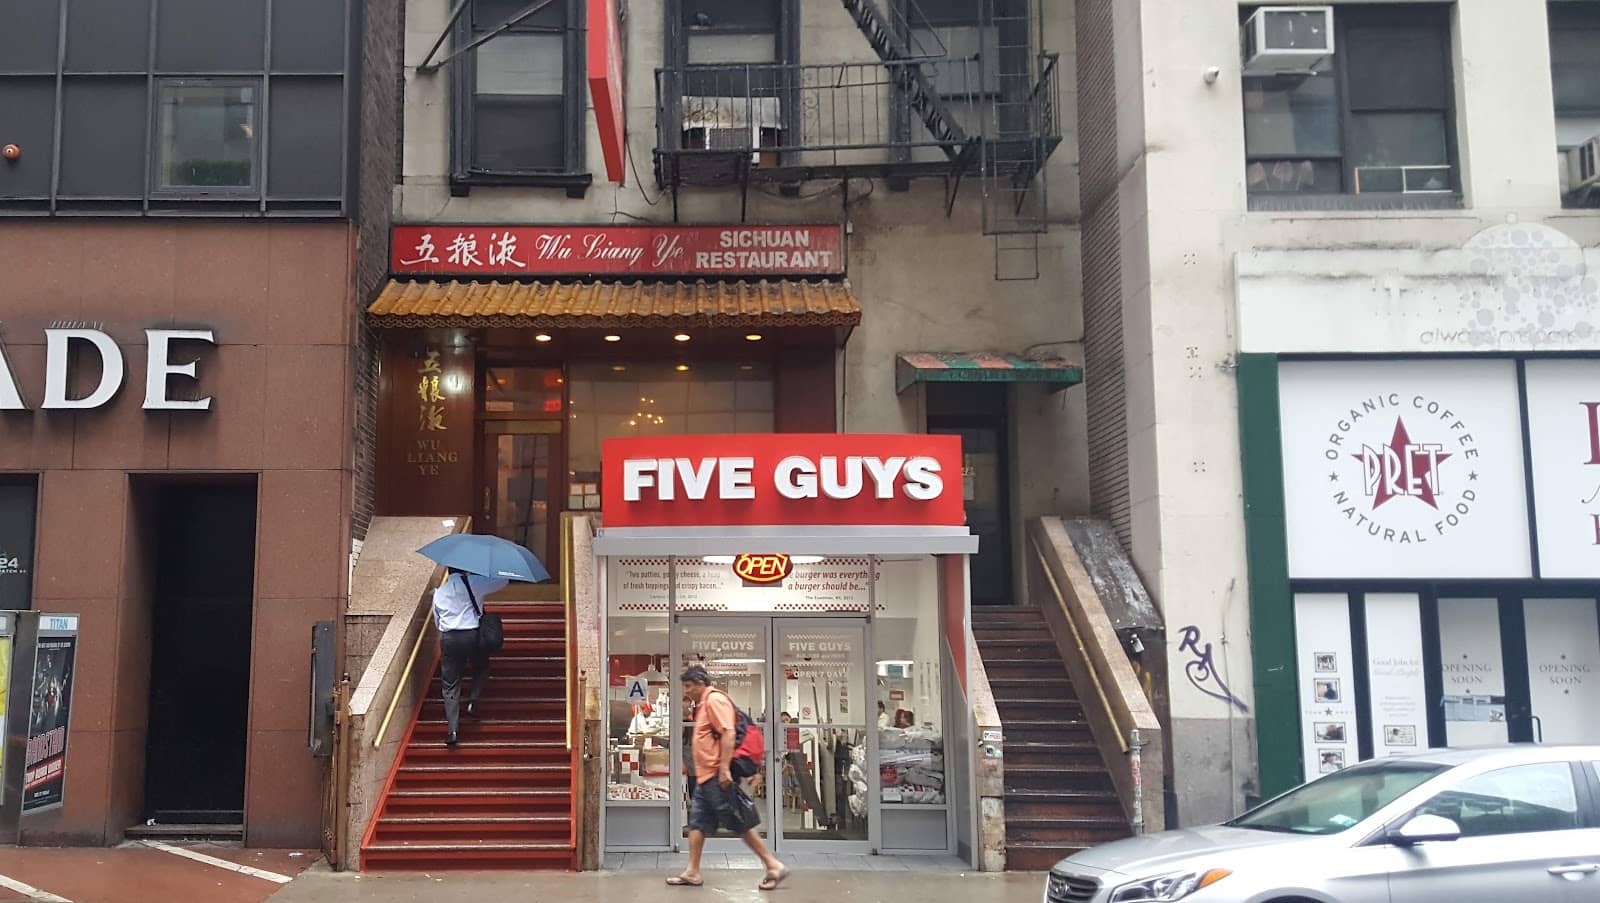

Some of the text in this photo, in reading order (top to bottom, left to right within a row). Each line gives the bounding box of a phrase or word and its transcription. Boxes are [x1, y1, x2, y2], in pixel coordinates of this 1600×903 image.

[719, 230, 810, 248] SICHUAN
[535, 232, 685, 268] Wu Liang Ye
[695, 250, 833, 269] RESTAURANT
[1325, 393, 1480, 461] ORGANIC COFFEE
[417, 440, 441, 450] WU
[407, 452, 458, 463] LIANG
[418, 464, 440, 475] YE
[1361, 443, 1443, 497] PRET
[623, 455, 944, 501] FIVE GUYS
[1332, 488, 1477, 544] NATURAL FOOD
[736, 556, 788, 576] OPEN
[795, 570, 821, 581] burger
[822, 571, 838, 579] was
[839, 570, 881, 581] everythg
[794, 581, 821, 592] burger
[821, 581, 846, 590] should
[692, 641, 755, 650] FIVE GUYS
[789, 641, 851, 651] FIVE GUYS
[1441, 663, 1492, 674] OPENING
[1539, 663, 1591, 674] OPENING
[793, 670, 818, 679] OPEN
[1450, 675, 1483, 685] SOON
[1549, 675, 1583, 685] SOON
[629, 681, 645, 698] A
